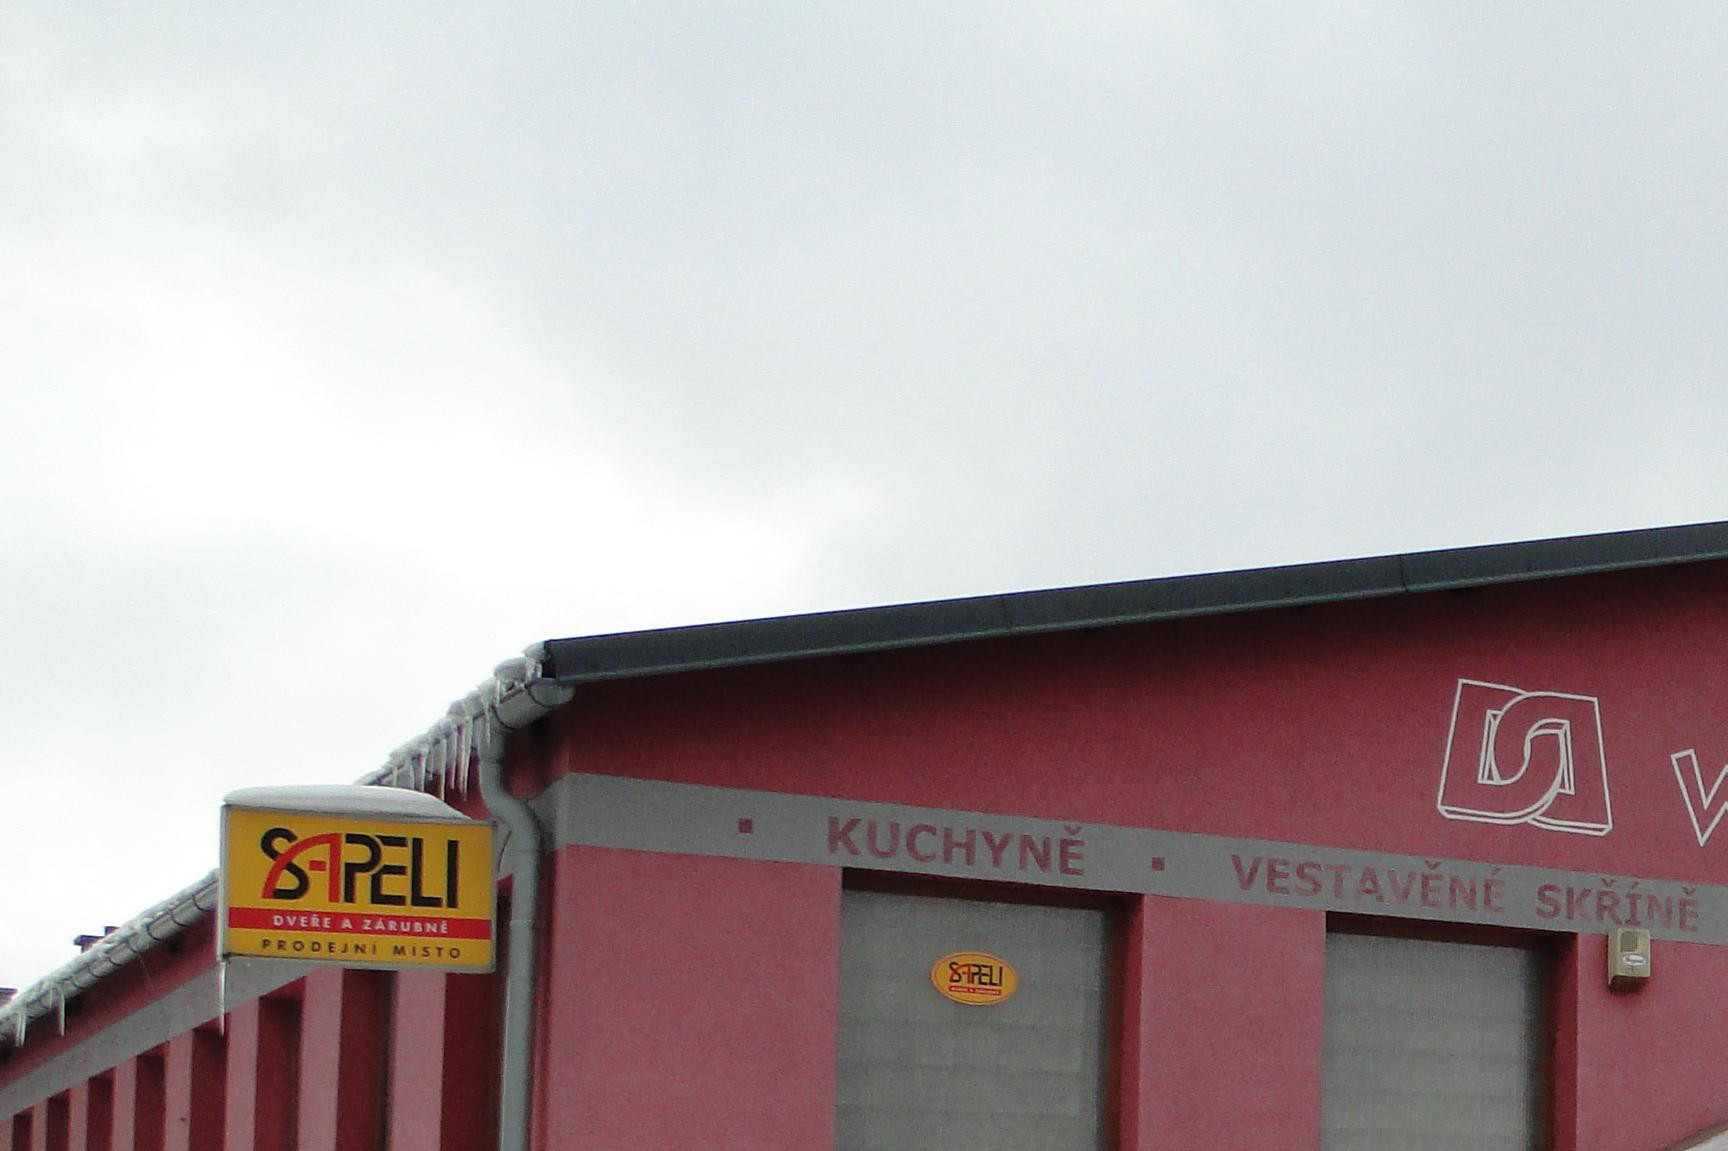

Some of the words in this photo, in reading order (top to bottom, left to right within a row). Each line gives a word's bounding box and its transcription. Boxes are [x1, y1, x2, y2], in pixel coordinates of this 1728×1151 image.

[260, 827, 459, 909] SAPELI
[826, 816, 1085, 876] KUCHYNĚ
[1231, 854, 1505, 914] VESTAVĚNÉ
[1536, 879, 1700, 931] SKŘÍNĚ
[273, 914, 331, 928] DVEŘE
[341, 917, 352, 929] A
[363, 914, 449, 933] ZÁRUBNĚ
[393, 942, 461, 958] MÍSTO
[949, 962, 1003, 986] SAPELI
